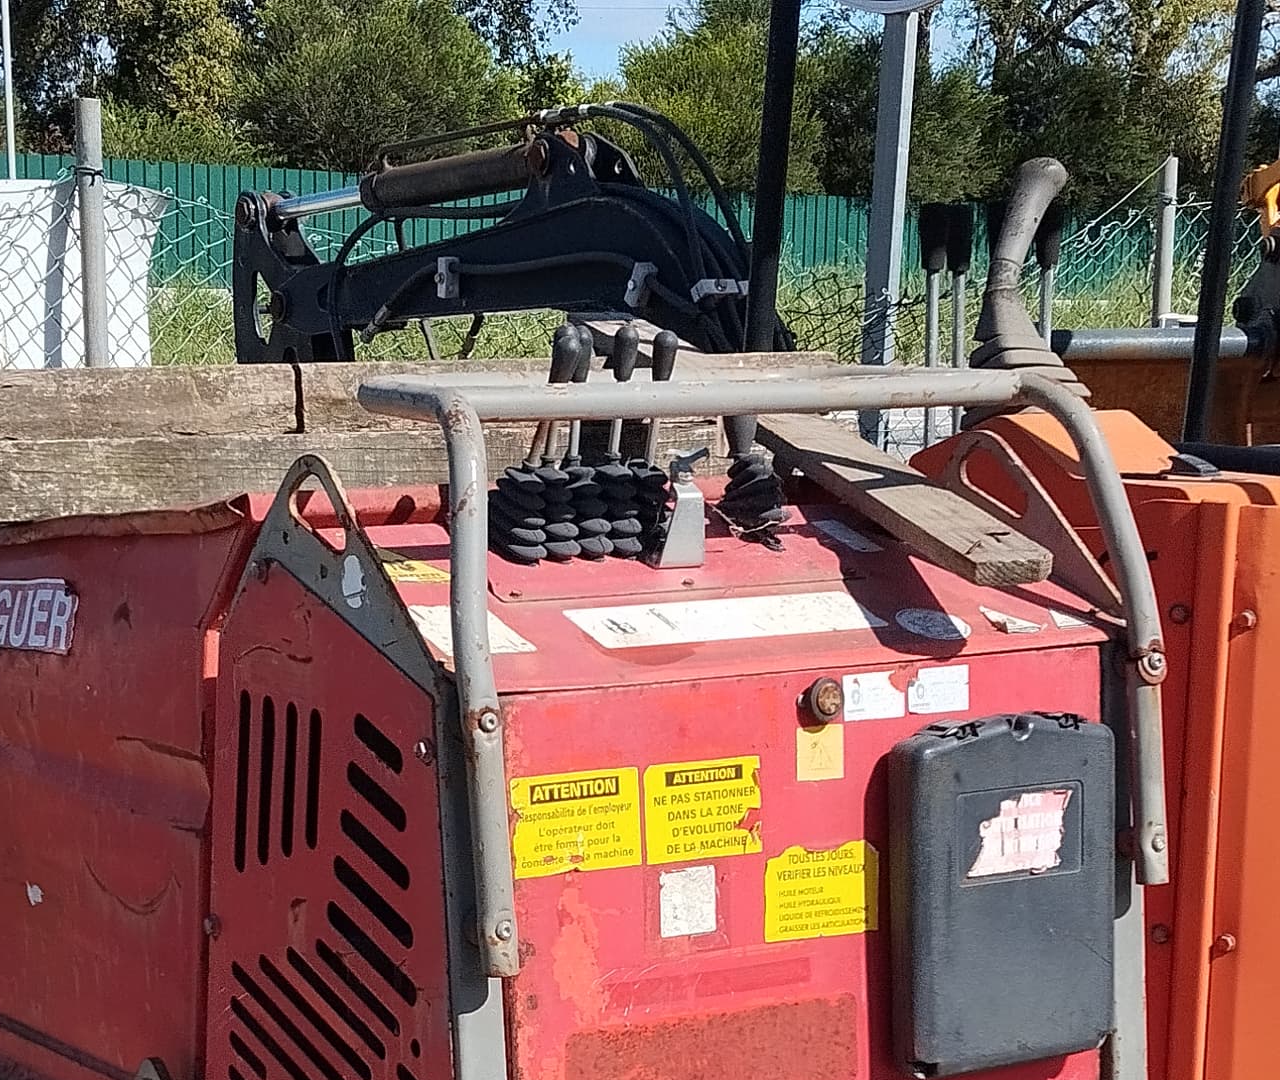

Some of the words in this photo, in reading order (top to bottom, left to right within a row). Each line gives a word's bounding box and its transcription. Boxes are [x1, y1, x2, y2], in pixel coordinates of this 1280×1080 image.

[673, 767, 736, 785] ATTENTION
[531, 778, 617, 802] ATTENTION
[653, 796, 667, 807] NE
[670, 793, 690, 805] PAS
[693, 786, 756, 802] STATIONNER
[577, 806, 587, 816] de
[588, 802, 633, 816] l'employeur
[667, 809, 697, 822] DANS
[700, 807, 713, 818] LA
[716, 803, 744, 816] ZONE
[596, 820, 615, 832] doit
[587, 836, 610, 848] pour
[612, 834, 621, 843] la
[666, 843, 681, 855] DE
[683, 842, 696, 853] LA
[700, 835, 748, 852] MACHINE
[521, 854, 564, 869] conte
[593, 847, 634, 860] machine
[788, 852, 810, 865] TOUS
[811, 851, 825, 863] LES
[826, 848, 854, 861] JOURS
[776, 869, 811, 881] VERIFIER
[813, 867, 826, 878] LES
[828, 863, 866, 877] NIVEAUX
